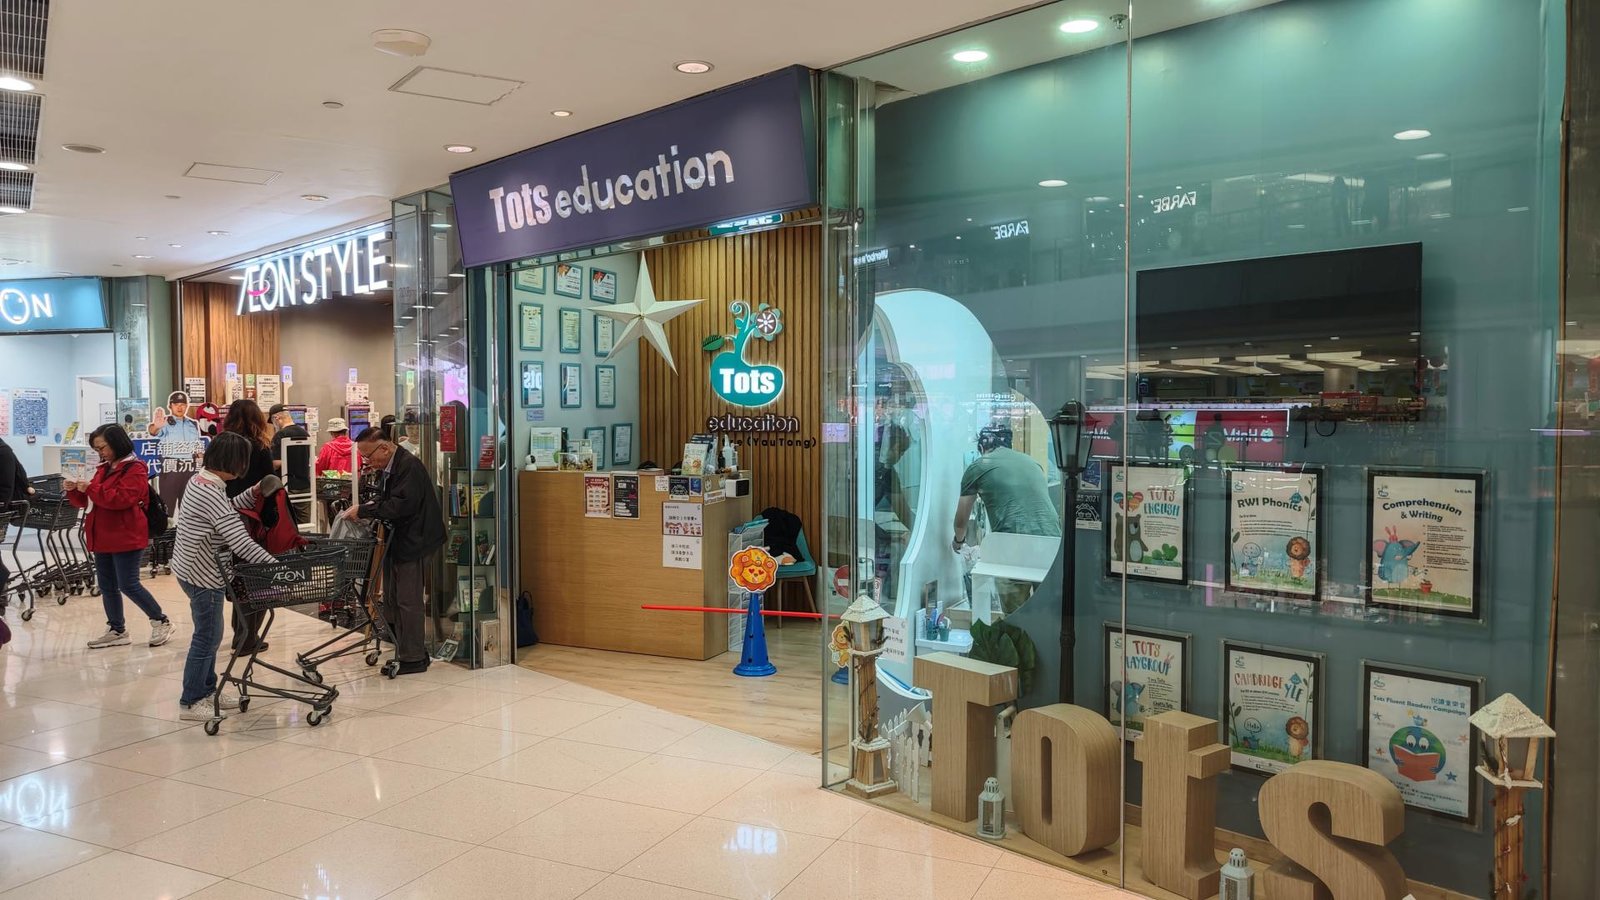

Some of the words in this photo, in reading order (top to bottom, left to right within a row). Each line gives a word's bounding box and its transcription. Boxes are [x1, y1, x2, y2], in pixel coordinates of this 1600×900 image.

[488, 182, 553, 234] Tots
[554, 144, 736, 220] education
[301, 231, 388, 305] STYLE
[719, 367, 776, 395] Tots
[707, 413, 800, 433] education
[1143, 502, 1181, 517] ENGLISH
[1237, 497, 1259, 508] RWI
[1262, 497, 1302, 512] Phonics
[1382, 498, 1462, 516] Comprehension
[1409, 510, 1443, 523] Writing
[1132, 640, 1160, 657] TOTS
[1386, 697, 1406, 706] Fluent
[1432, 705, 1467, 716] Campaign
